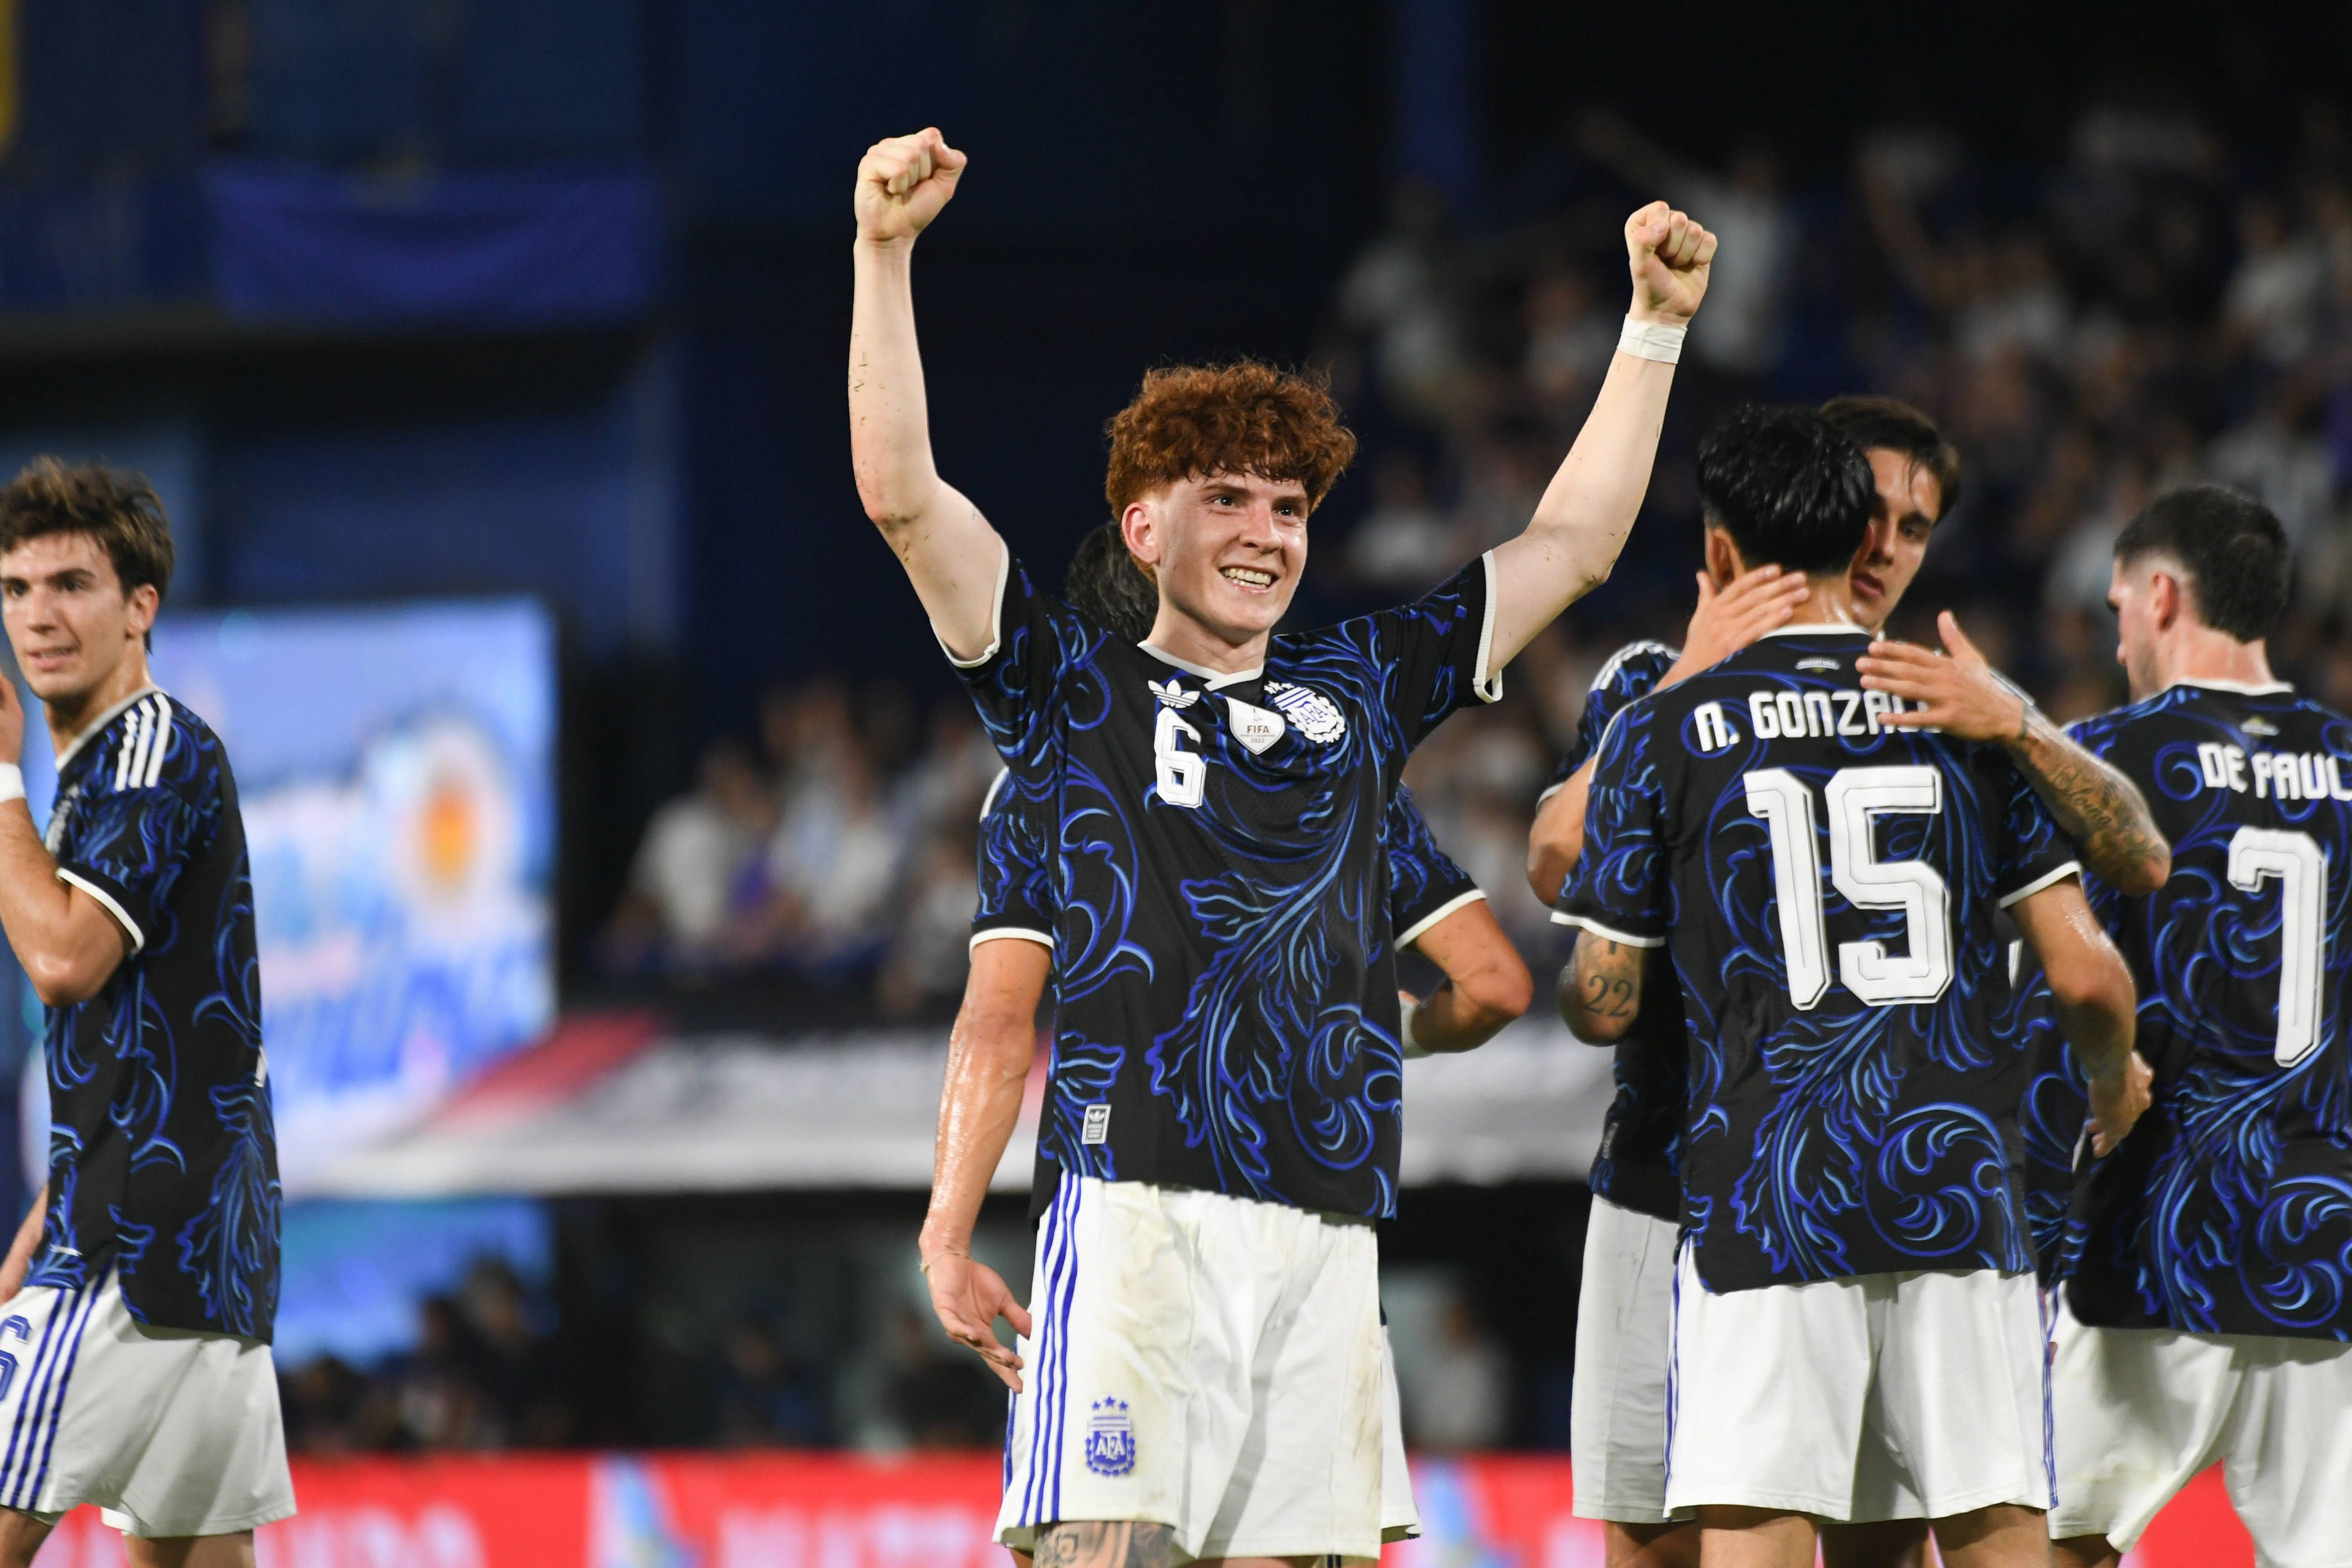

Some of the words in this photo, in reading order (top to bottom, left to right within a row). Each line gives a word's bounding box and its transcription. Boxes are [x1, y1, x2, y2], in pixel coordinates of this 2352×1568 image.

[1246, 725, 1269, 733] FIFA
[1294, 701, 1328, 725] AFA
[1748, 691, 1942, 738] GONZAL
[1154, 707, 1206, 808] 6
[2197, 743, 2248, 793] DE
[2251, 752, 2352, 801] PAUL
[1743, 765, 1954, 1011] 15
[2228, 826, 2328, 1068] 7
[1581, 975, 1633, 1017] 22
[1095, 1431, 1125, 1461] AFA
